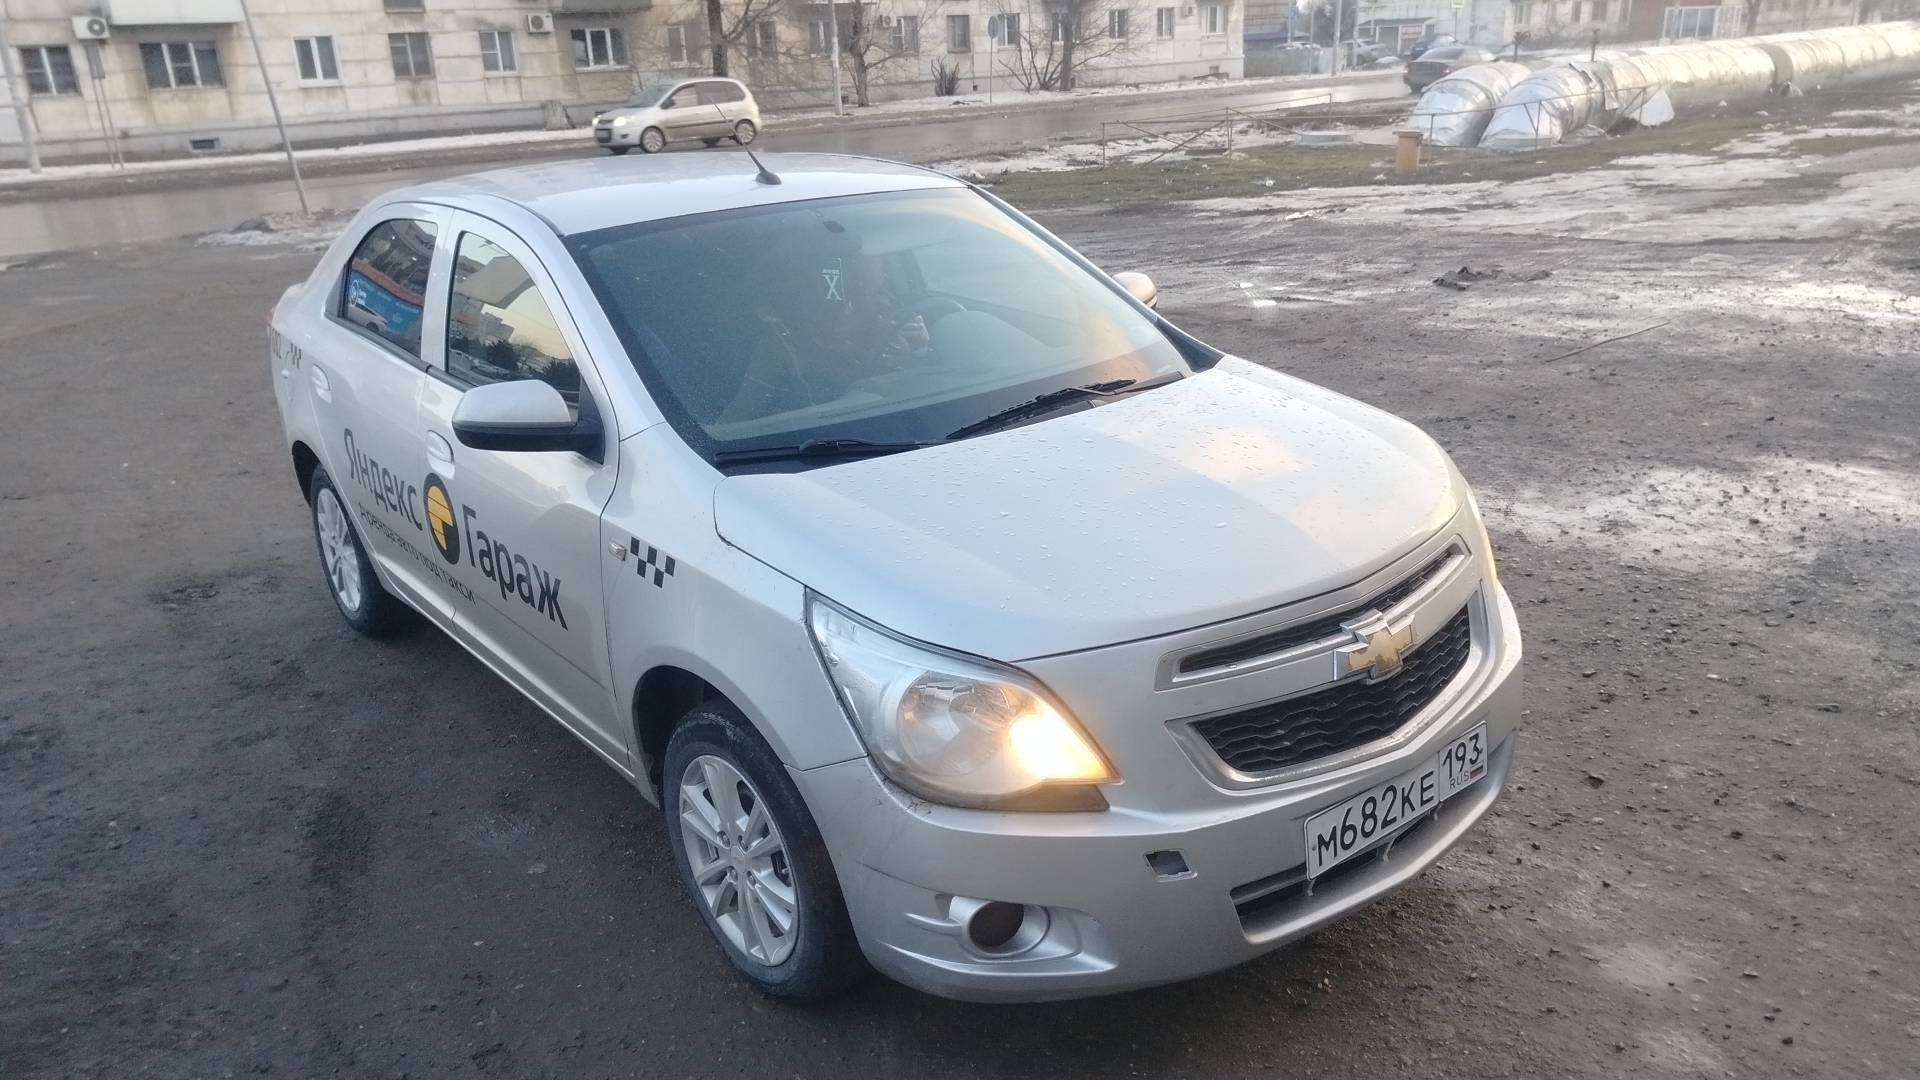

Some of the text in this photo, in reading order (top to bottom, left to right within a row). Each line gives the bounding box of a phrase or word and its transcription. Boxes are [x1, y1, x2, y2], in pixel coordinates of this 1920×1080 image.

[344, 427, 568, 631] Яндекс Гараж
[440, 566, 476, 606] такси
[1443, 732, 1483, 780] 193
[1450, 771, 1470, 789] RUS
